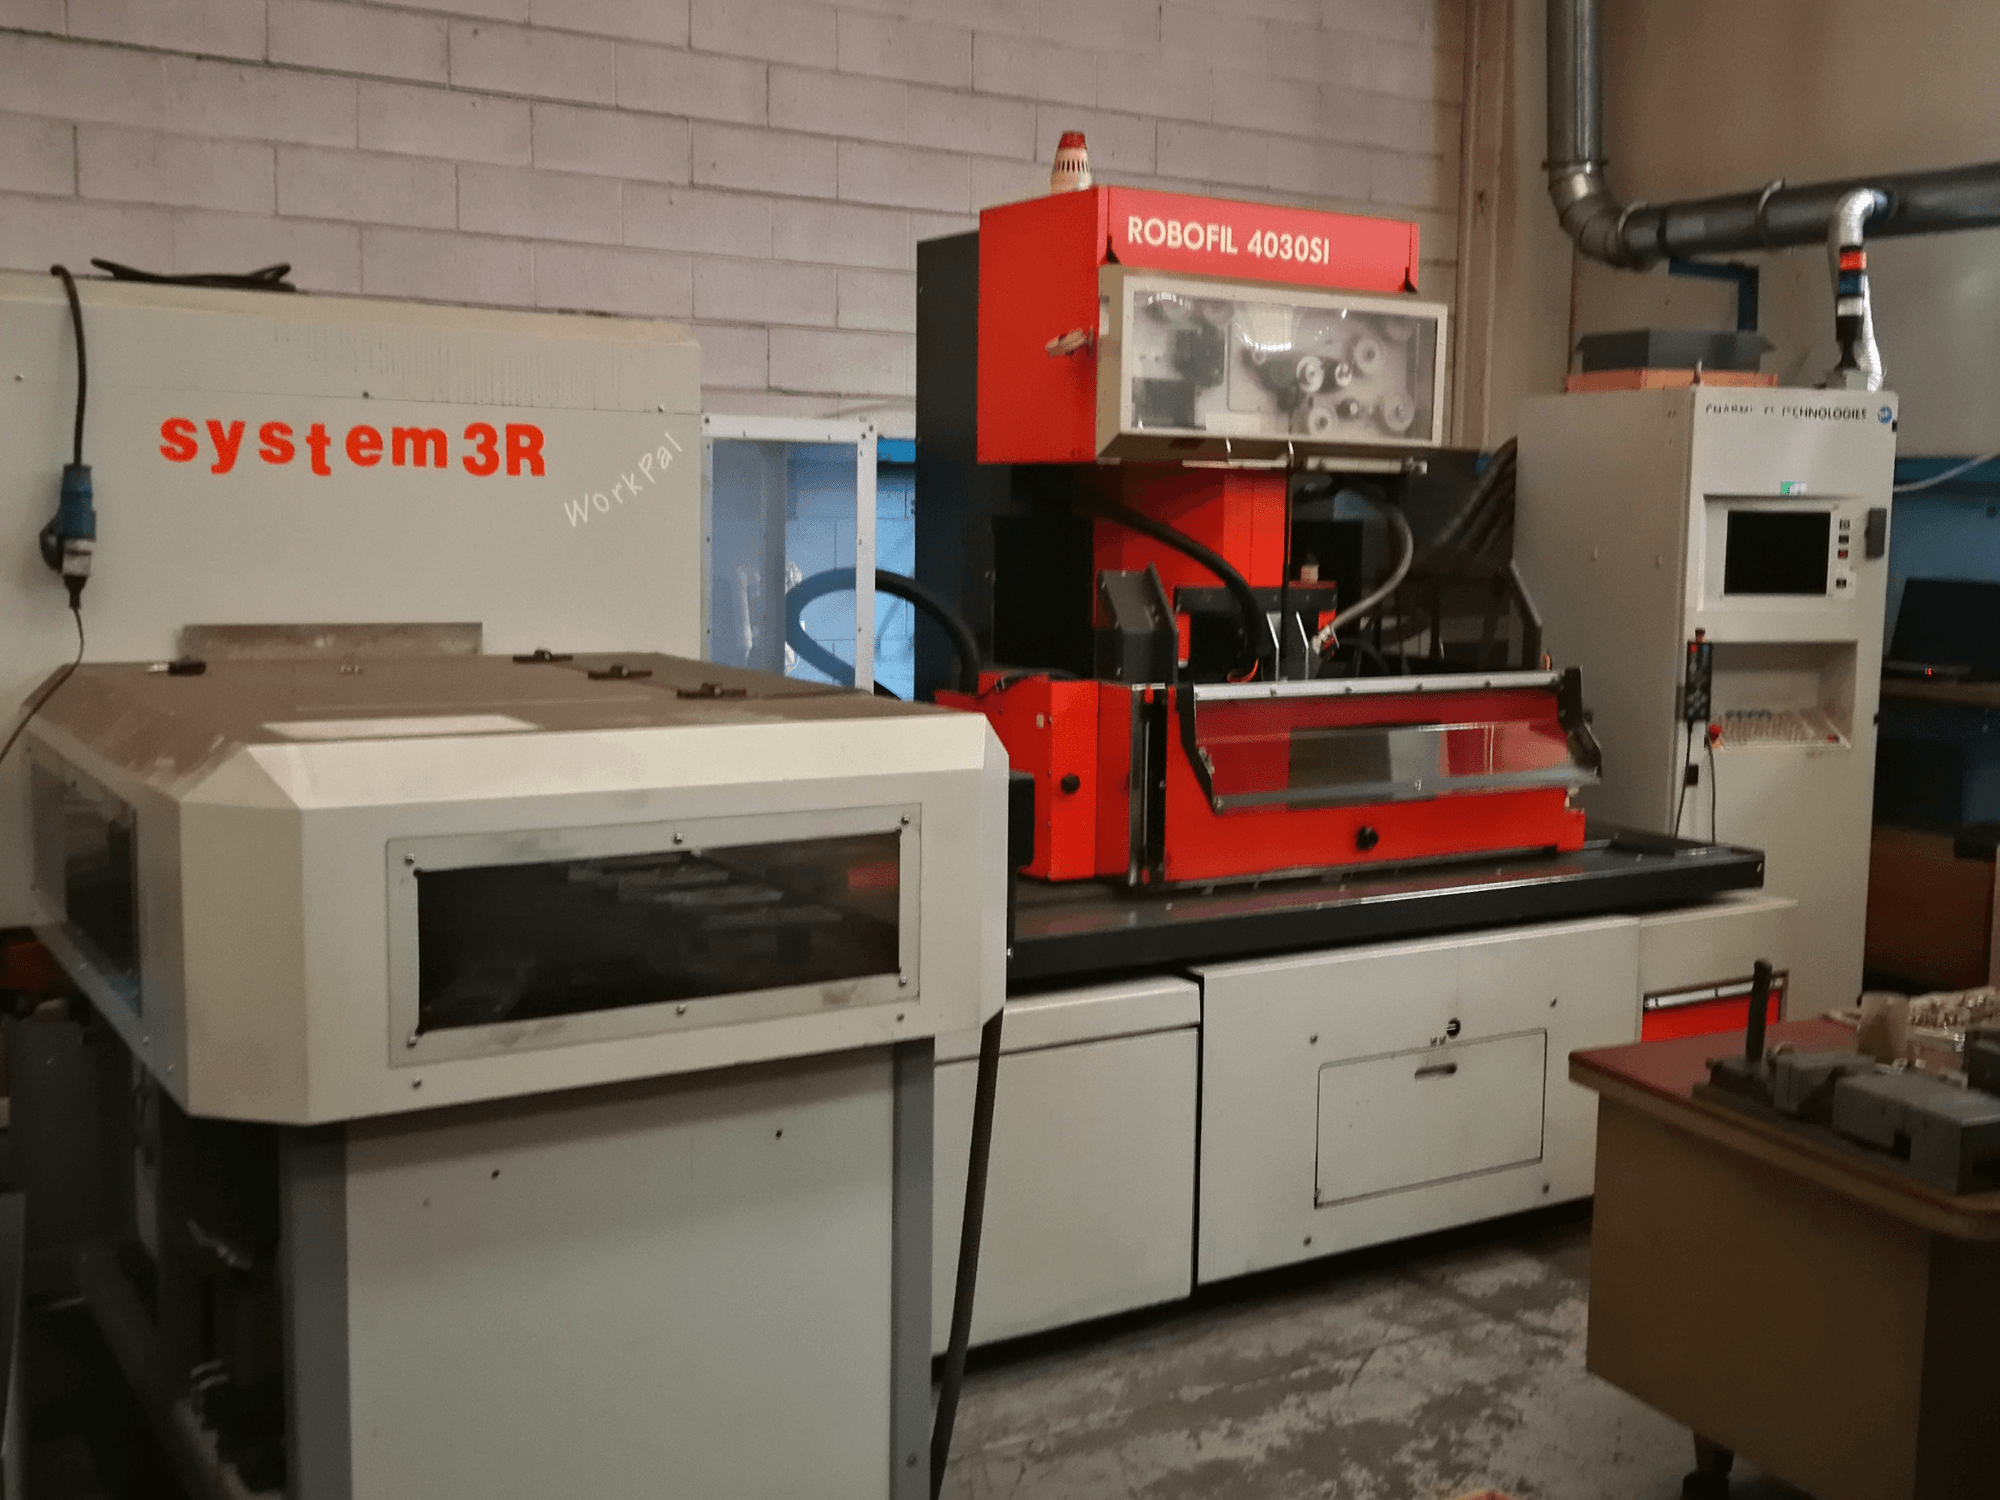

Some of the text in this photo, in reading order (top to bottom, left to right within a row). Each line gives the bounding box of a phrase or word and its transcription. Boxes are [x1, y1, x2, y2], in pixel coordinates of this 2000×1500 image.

[1128, 215, 1330, 265] ROBOFIL 4030SI
[563, 431, 684, 528] WorkPal
